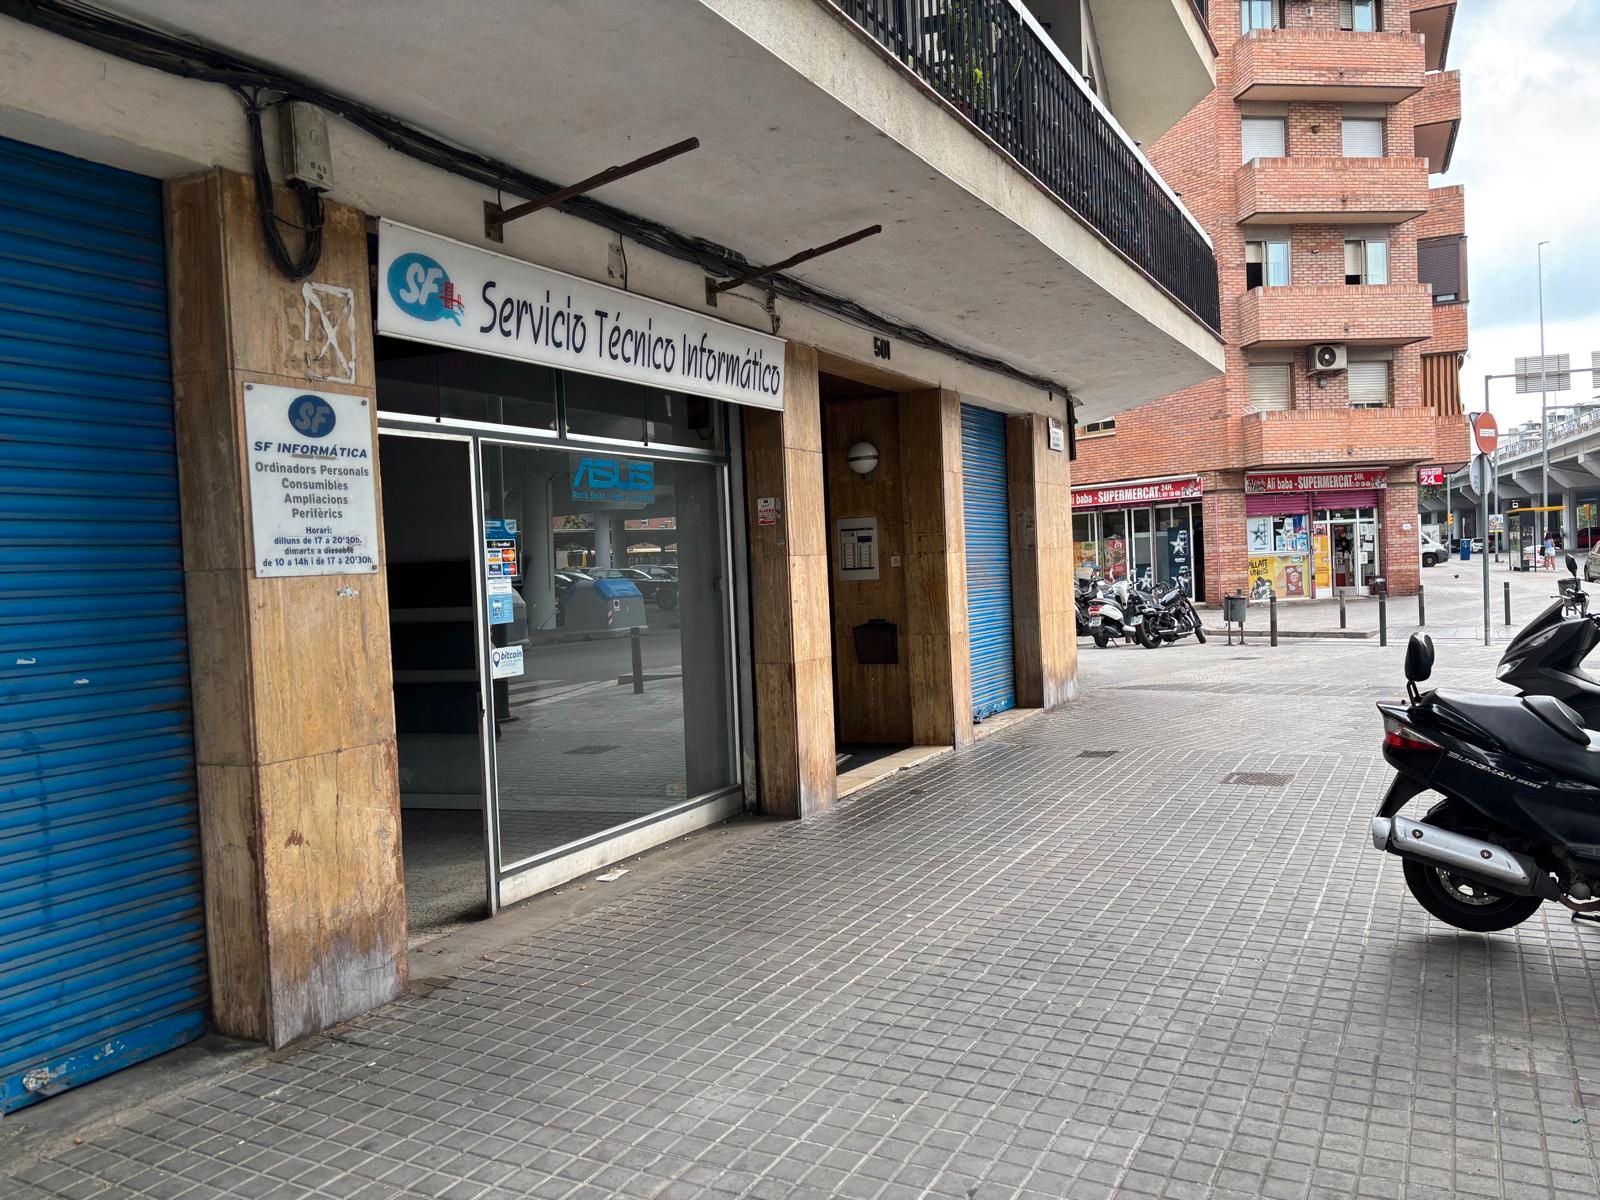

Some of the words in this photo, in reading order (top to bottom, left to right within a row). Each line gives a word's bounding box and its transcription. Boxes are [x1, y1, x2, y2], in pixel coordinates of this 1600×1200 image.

[399, 262, 443, 305] SF
[480, 281, 587, 354] Servicio
[595, 309, 676, 373] Técnico
[682, 332, 780, 395] Informático
[873, 336, 891, 361] 501
[295, 401, 330, 433] SF
[254, 441, 273, 452] SF
[277, 443, 367, 459] INFORMÁTICA
[255, 461, 316, 475] Ordinadors
[320, 465, 369, 477] Personals
[572, 457, 654, 491] ASUS
[281, 477, 348, 490] Consumibles
[1278, 477, 1293, 489] baba
[1298, 474, 1353, 489] SUPERMERCAT
[284, 493, 348, 505] Ampliacions
[1076, 493, 1093, 504] baba
[1098, 486, 1160, 503] SUPERMERCAT
[292, 508, 343, 519] Perifèrics
[305, 526, 332, 534] Horari:
[274, 536, 300, 545] dilluns
[302, 536, 312, 544] de
[314, 536, 322, 544] 17
[284, 546, 315, 555] dimarts
[263, 558, 272, 567] de
[275, 558, 284, 567] 10
[294, 558, 308, 566] 14h
[316, 557, 325, 565] de
[327, 557, 335, 565] 17
[501, 650, 523, 660] bitcoin
[1447, 750, 1516, 780] BURGMAN
